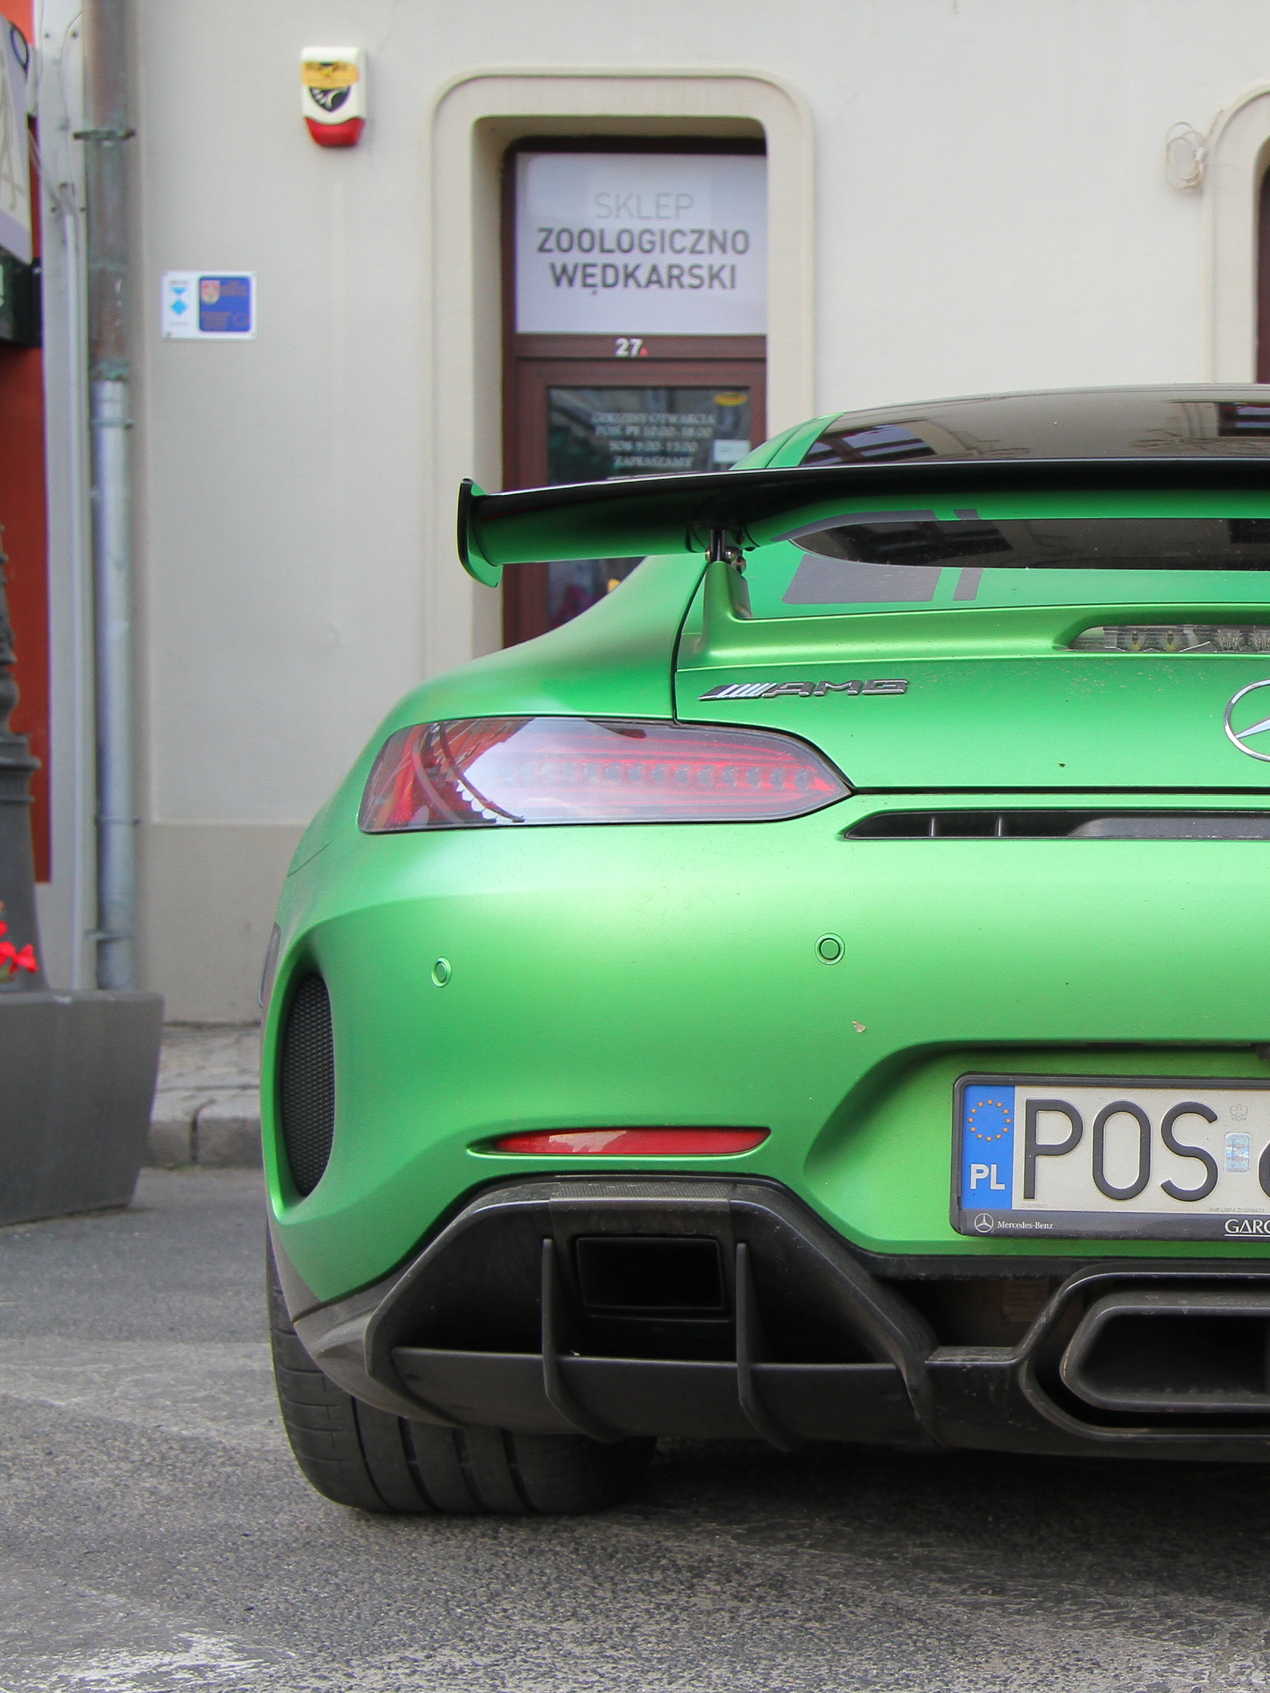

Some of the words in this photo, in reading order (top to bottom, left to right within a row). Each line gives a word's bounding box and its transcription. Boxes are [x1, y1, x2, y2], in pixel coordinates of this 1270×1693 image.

[595, 192, 695, 220] SKLEP
[537, 227, 750, 254] ZOOLOGICZNO
[549, 261, 736, 296] WĘDKARSKI
[615, 337, 644, 358] 27
[762, 678, 909, 698] AMG
[1023, 1098, 1219, 1202] POS
[970, 1163, 1005, 1190] PL
[997, 1220, 1054, 1230] Mercedes-Benz
